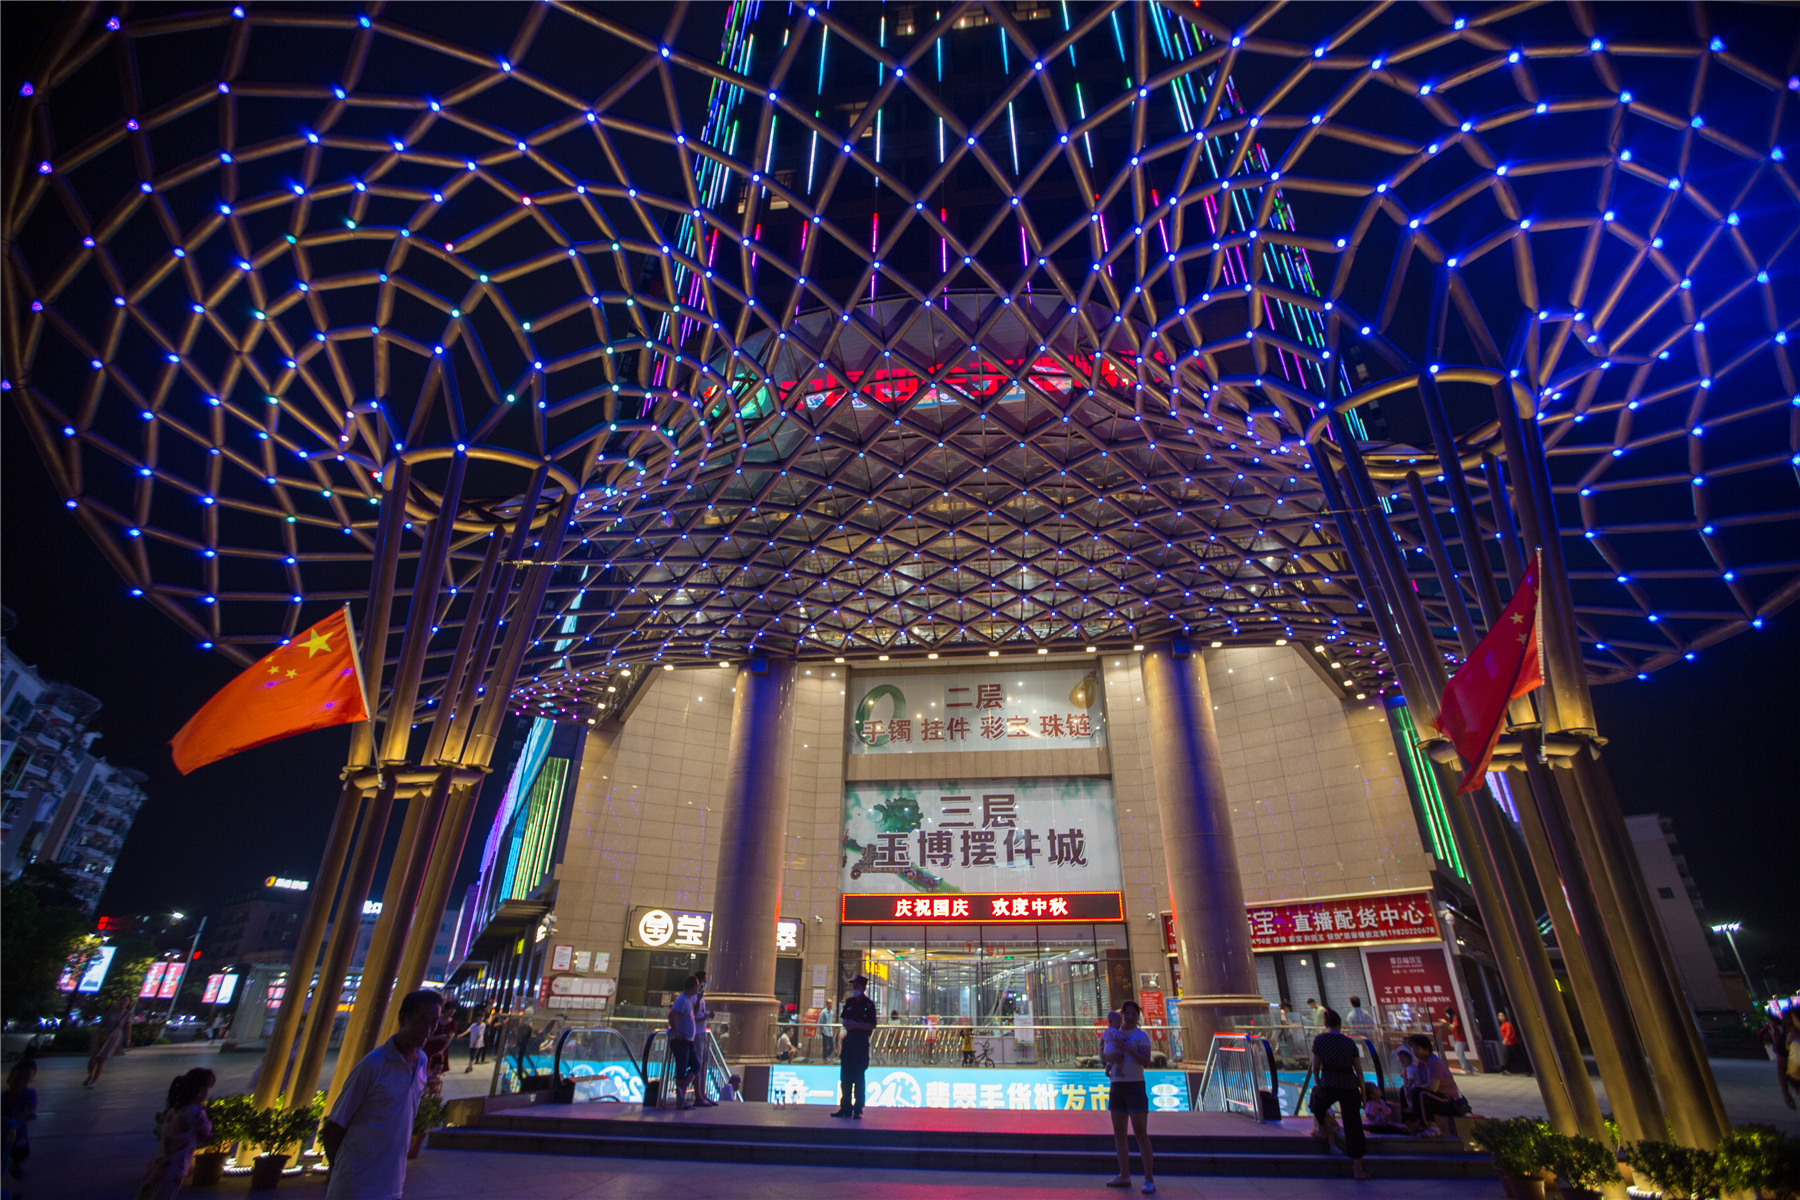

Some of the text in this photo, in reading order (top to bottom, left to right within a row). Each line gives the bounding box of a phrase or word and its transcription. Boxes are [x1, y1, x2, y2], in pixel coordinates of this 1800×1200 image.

[945, 683, 1004, 710] 二层
[861, 713, 1092, 744] 手镯 挂件 彩宝 珠链
[938, 794, 1018, 829] 三层
[873, 828, 1088, 868] 玉博摆件城
[895, 897, 1069, 917] 庆祝国庆 欢度中秋
[1292, 904, 1425, 933] 直播配货中心
[1304, 933, 1325, 942] 和田玉
[1388, 926, 1436, 937] 19820220678
